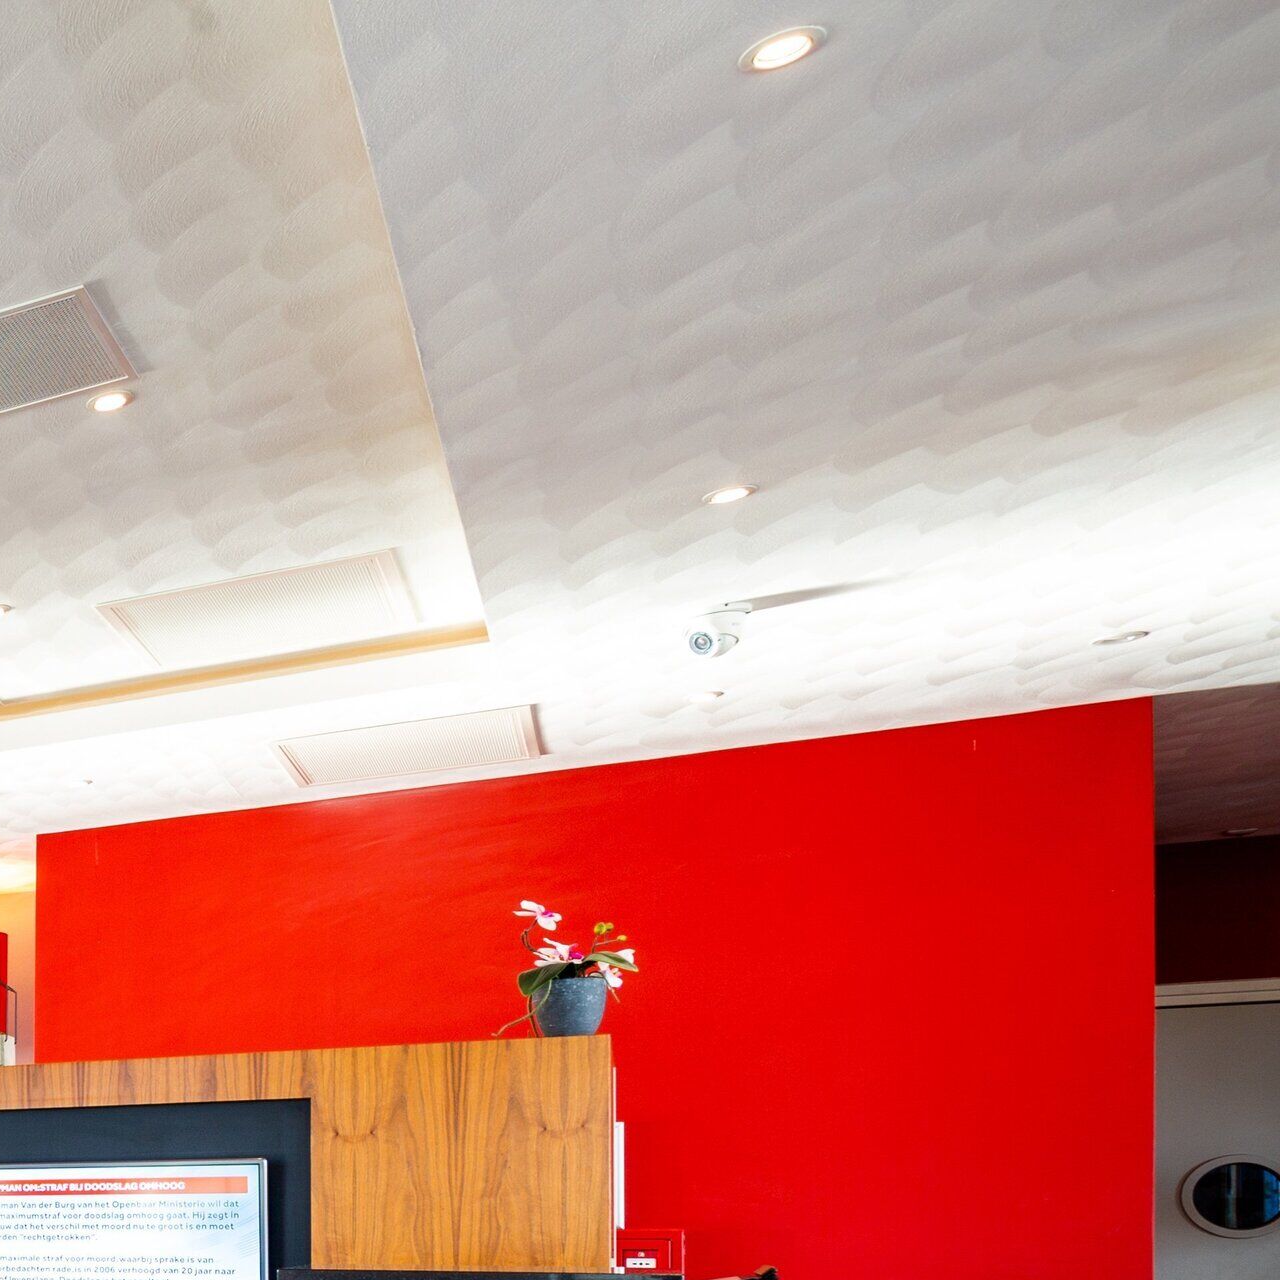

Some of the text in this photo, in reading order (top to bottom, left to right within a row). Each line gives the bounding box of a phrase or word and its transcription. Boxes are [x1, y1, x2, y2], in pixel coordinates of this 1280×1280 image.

[84, 1182, 138, 1191] DOODSLAG
[139, 1182, 185, 1190] OMHOOG
[55, 1201, 75, 1210] Burg
[112, 1201, 156, 1209] Openbaar
[158, 1200, 205, 1208] Ministerie
[208, 1200, 221, 1208] wil
[84, 1212, 124, 1221] doodslag
[126, 1211, 164, 1221] omhoog
[192, 1212, 205, 1220] Hij
[207, 1212, 229, 1220] zegt
[230, 1211, 239, 1219] in
[102, 1222, 131, 1230] moord
[158, 1223, 183, 1231] groot
[154, 1256, 184, 1264] sprake
[117, 1267, 160, 1275] verhoogd
[194, 1268, 212, 1276] jaar
